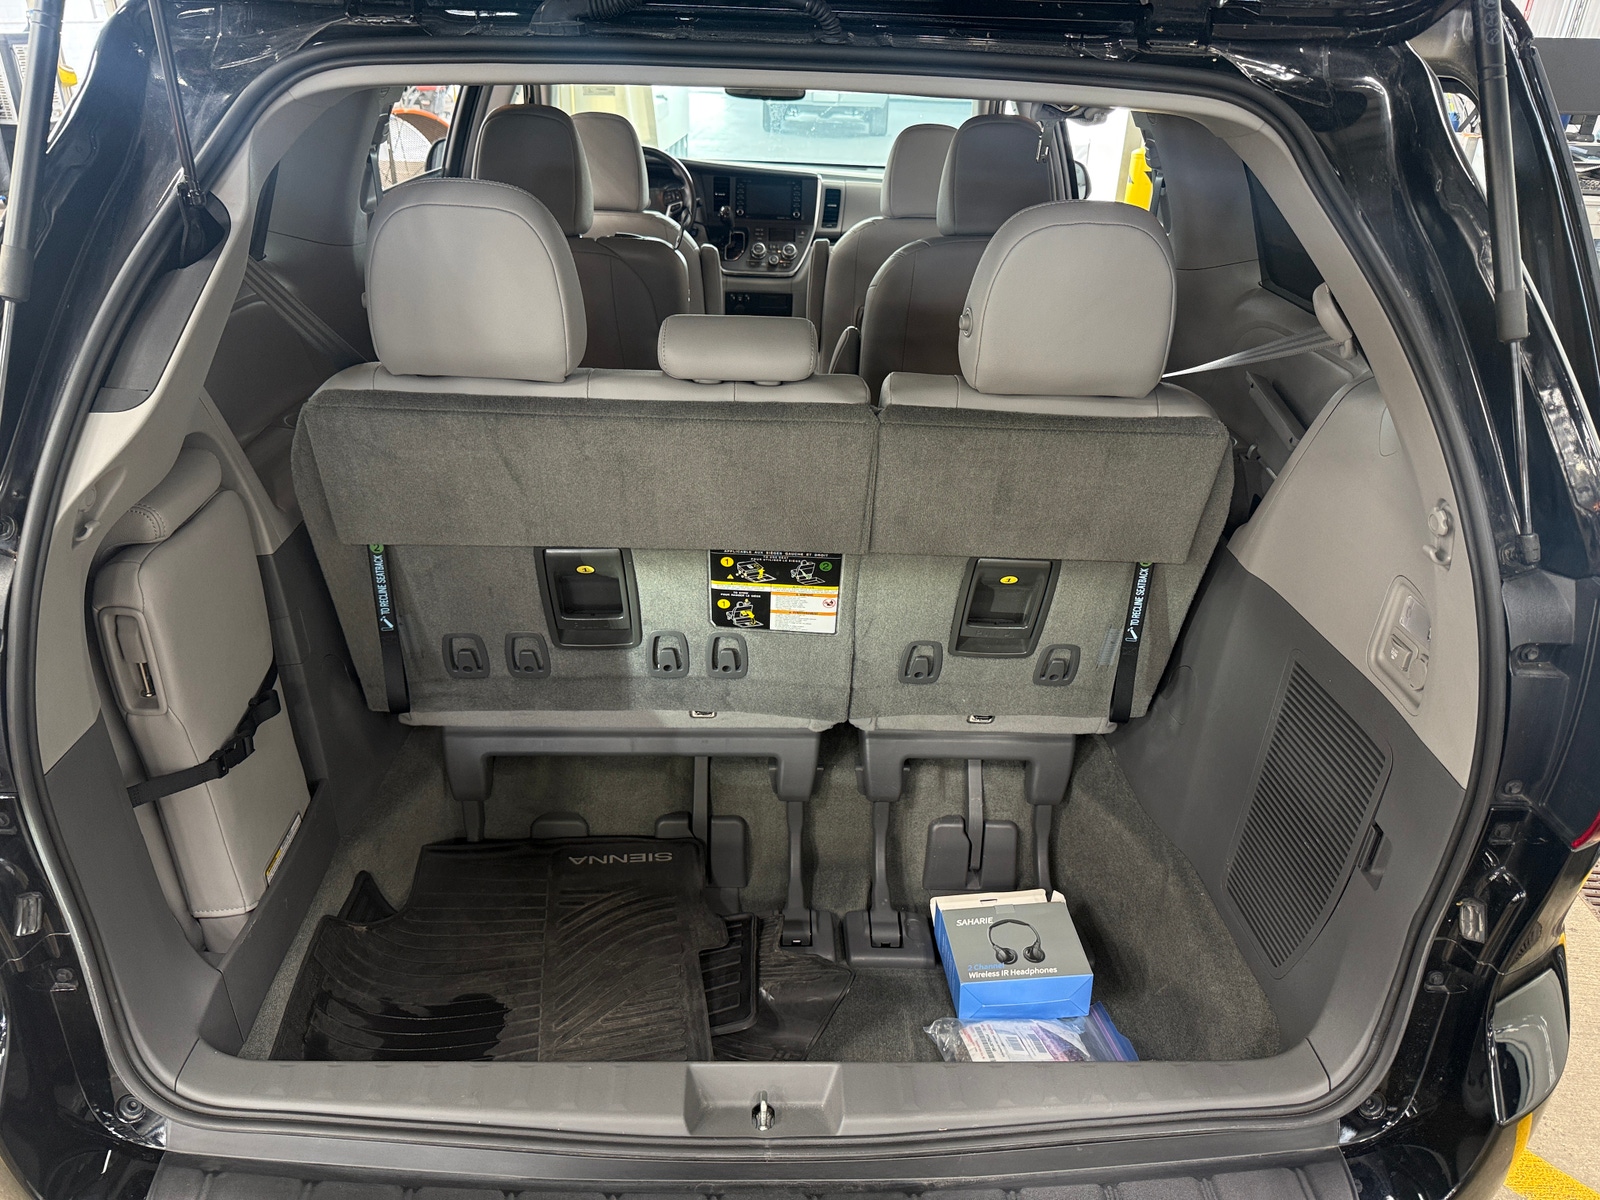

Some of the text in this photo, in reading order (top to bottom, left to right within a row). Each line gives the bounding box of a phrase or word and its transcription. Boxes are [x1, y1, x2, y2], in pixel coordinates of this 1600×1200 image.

[373, 554, 390, 615] TO RECLINE SEATBACK
[1136, 568, 1149, 596] SEATBACK
[1131, 596, 1144, 619] RECLINE
[568, 852, 672, 864] SIENNA
[956, 916, 994, 927] SAHARIE
[974, 962, 1005, 971] Channel
[968, 970, 1000, 979] Wireless
[1010, 967, 1058, 976] Headphones
